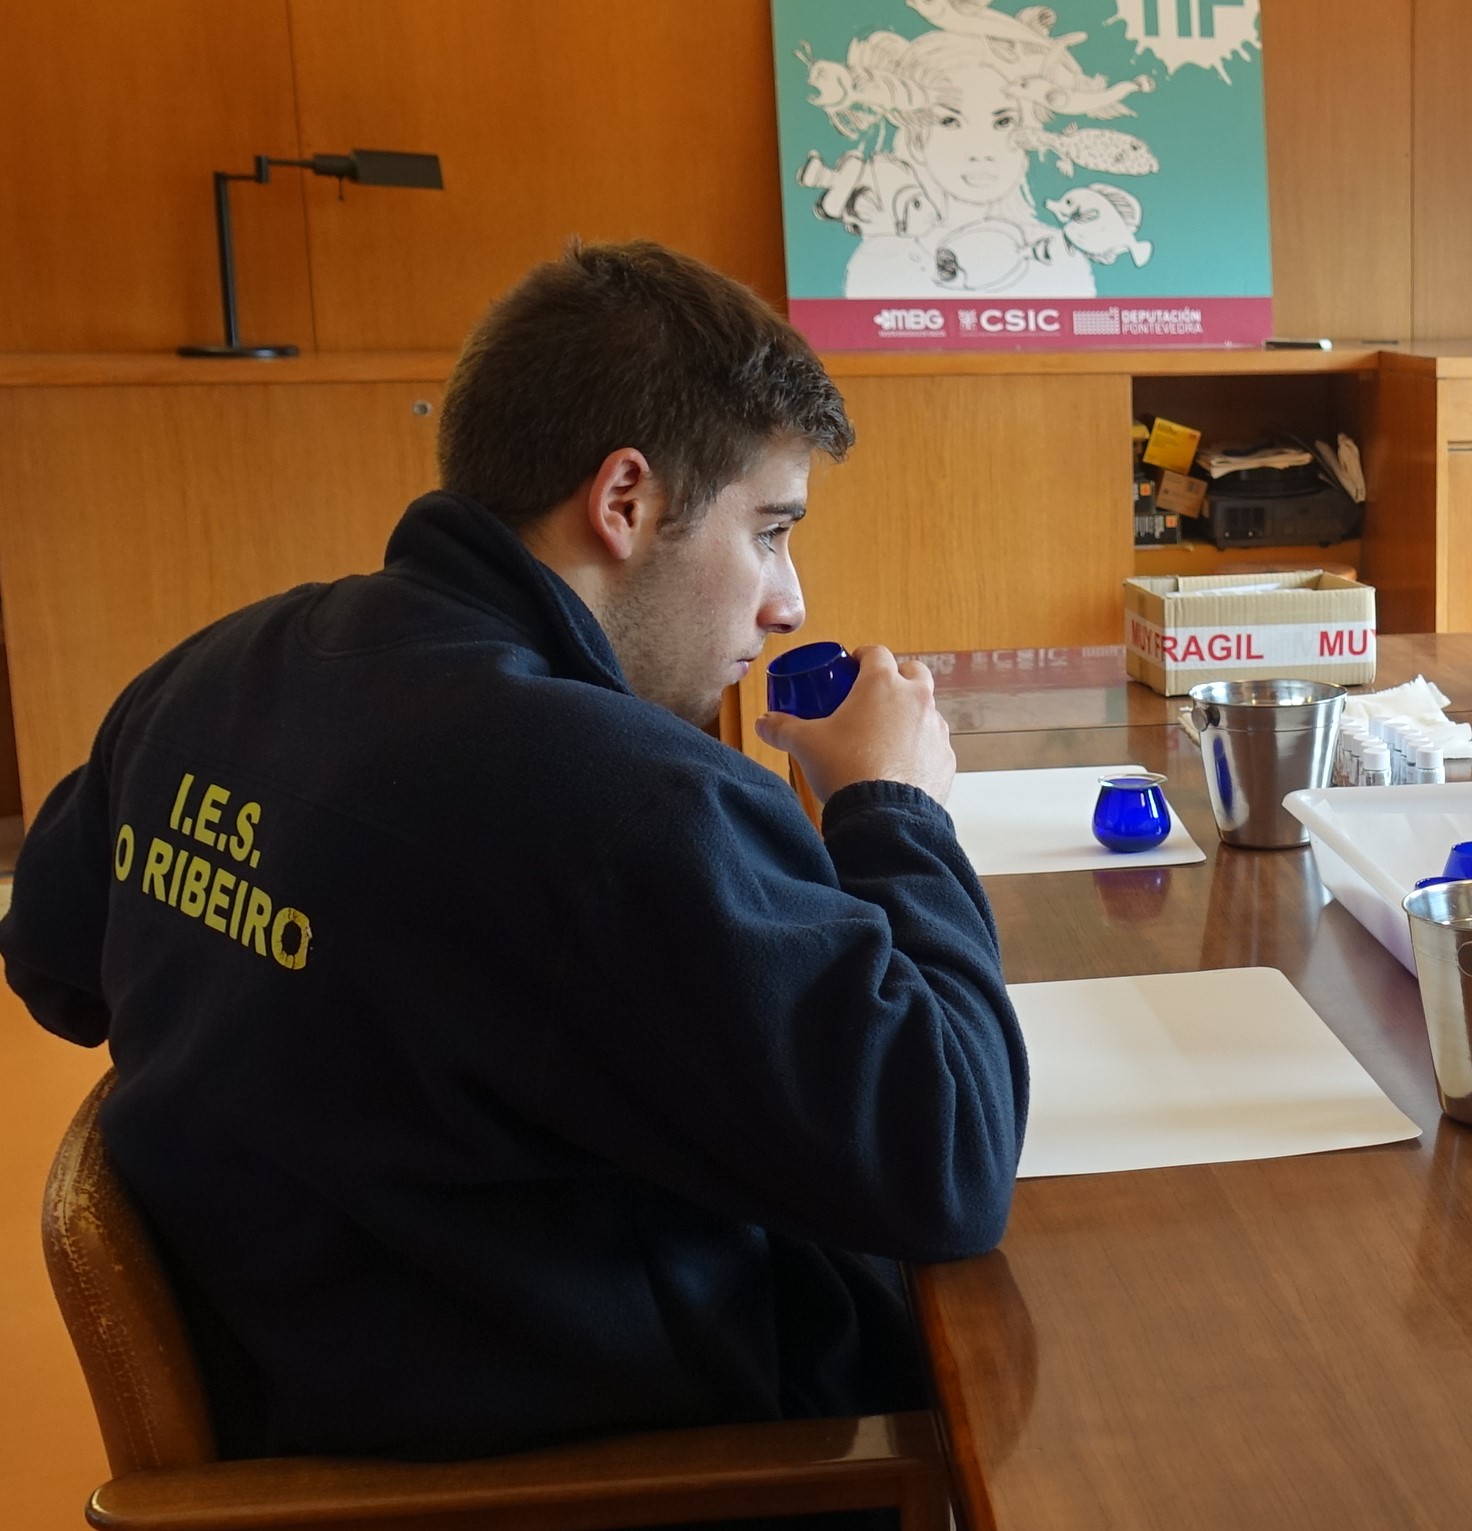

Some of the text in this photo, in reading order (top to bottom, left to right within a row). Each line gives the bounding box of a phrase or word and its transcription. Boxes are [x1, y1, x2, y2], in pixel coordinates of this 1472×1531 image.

[979, 309, 1061, 333] CSIC
[1121, 307, 1202, 323] DEPUTACIÓN
[1121, 323, 1204, 335] PONTEVEDRA
[1131, 619, 1264, 662] MUY FRAGIL
[1319, 629, 1376, 657] MU
[170, 773, 262, 868] I.E.S.
[115, 824, 312, 970] O RIBEIRO
